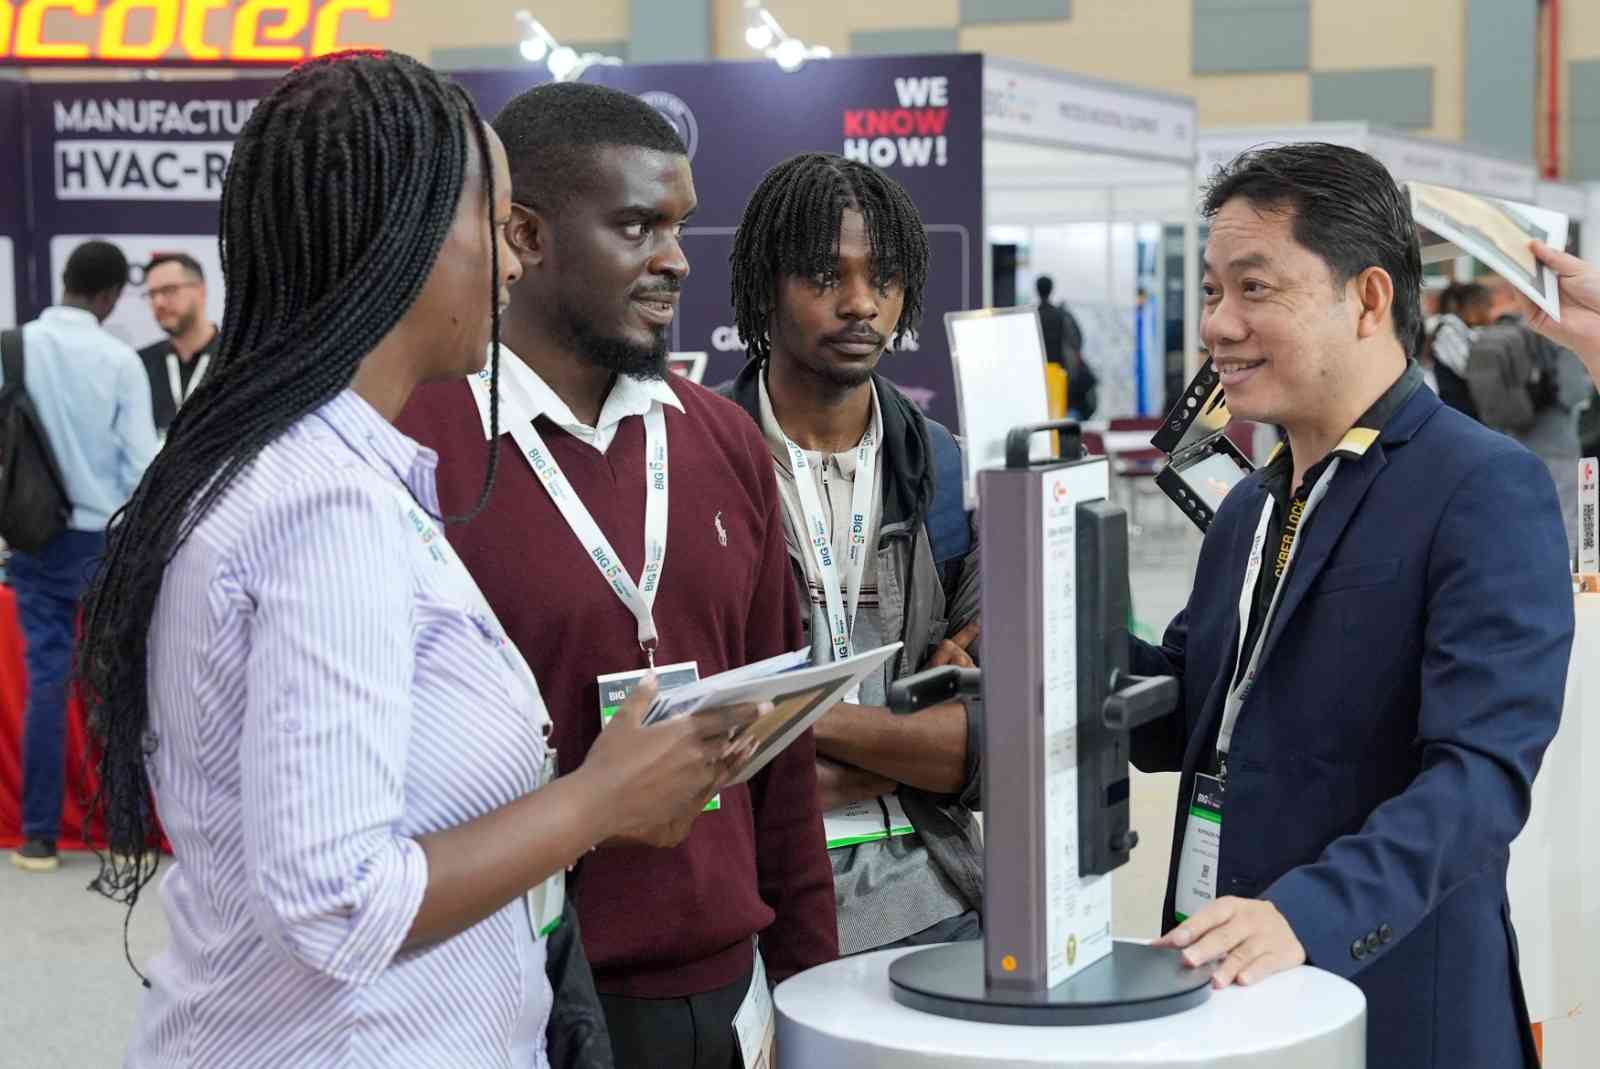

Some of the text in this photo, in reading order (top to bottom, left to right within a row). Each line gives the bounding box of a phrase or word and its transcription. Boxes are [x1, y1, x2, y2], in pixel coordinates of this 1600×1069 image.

[0, 0, 393, 60] cotec
[895, 75, 948, 108] WE
[844, 110, 947, 137] KNOW
[843, 136, 947, 168] HOW!
[528, 447, 546, 470] BIG
[655, 472, 665, 489] BIG
[852, 514, 862, 533] BIG
[592, 547, 610, 568] BIG
[820, 547, 831, 566] BIG
[1275, 535, 1293, 577] CYBER
[645, 573, 657, 592] BIG
[840, 646, 848, 658] IG
[609, 690, 625, 702] BIG
